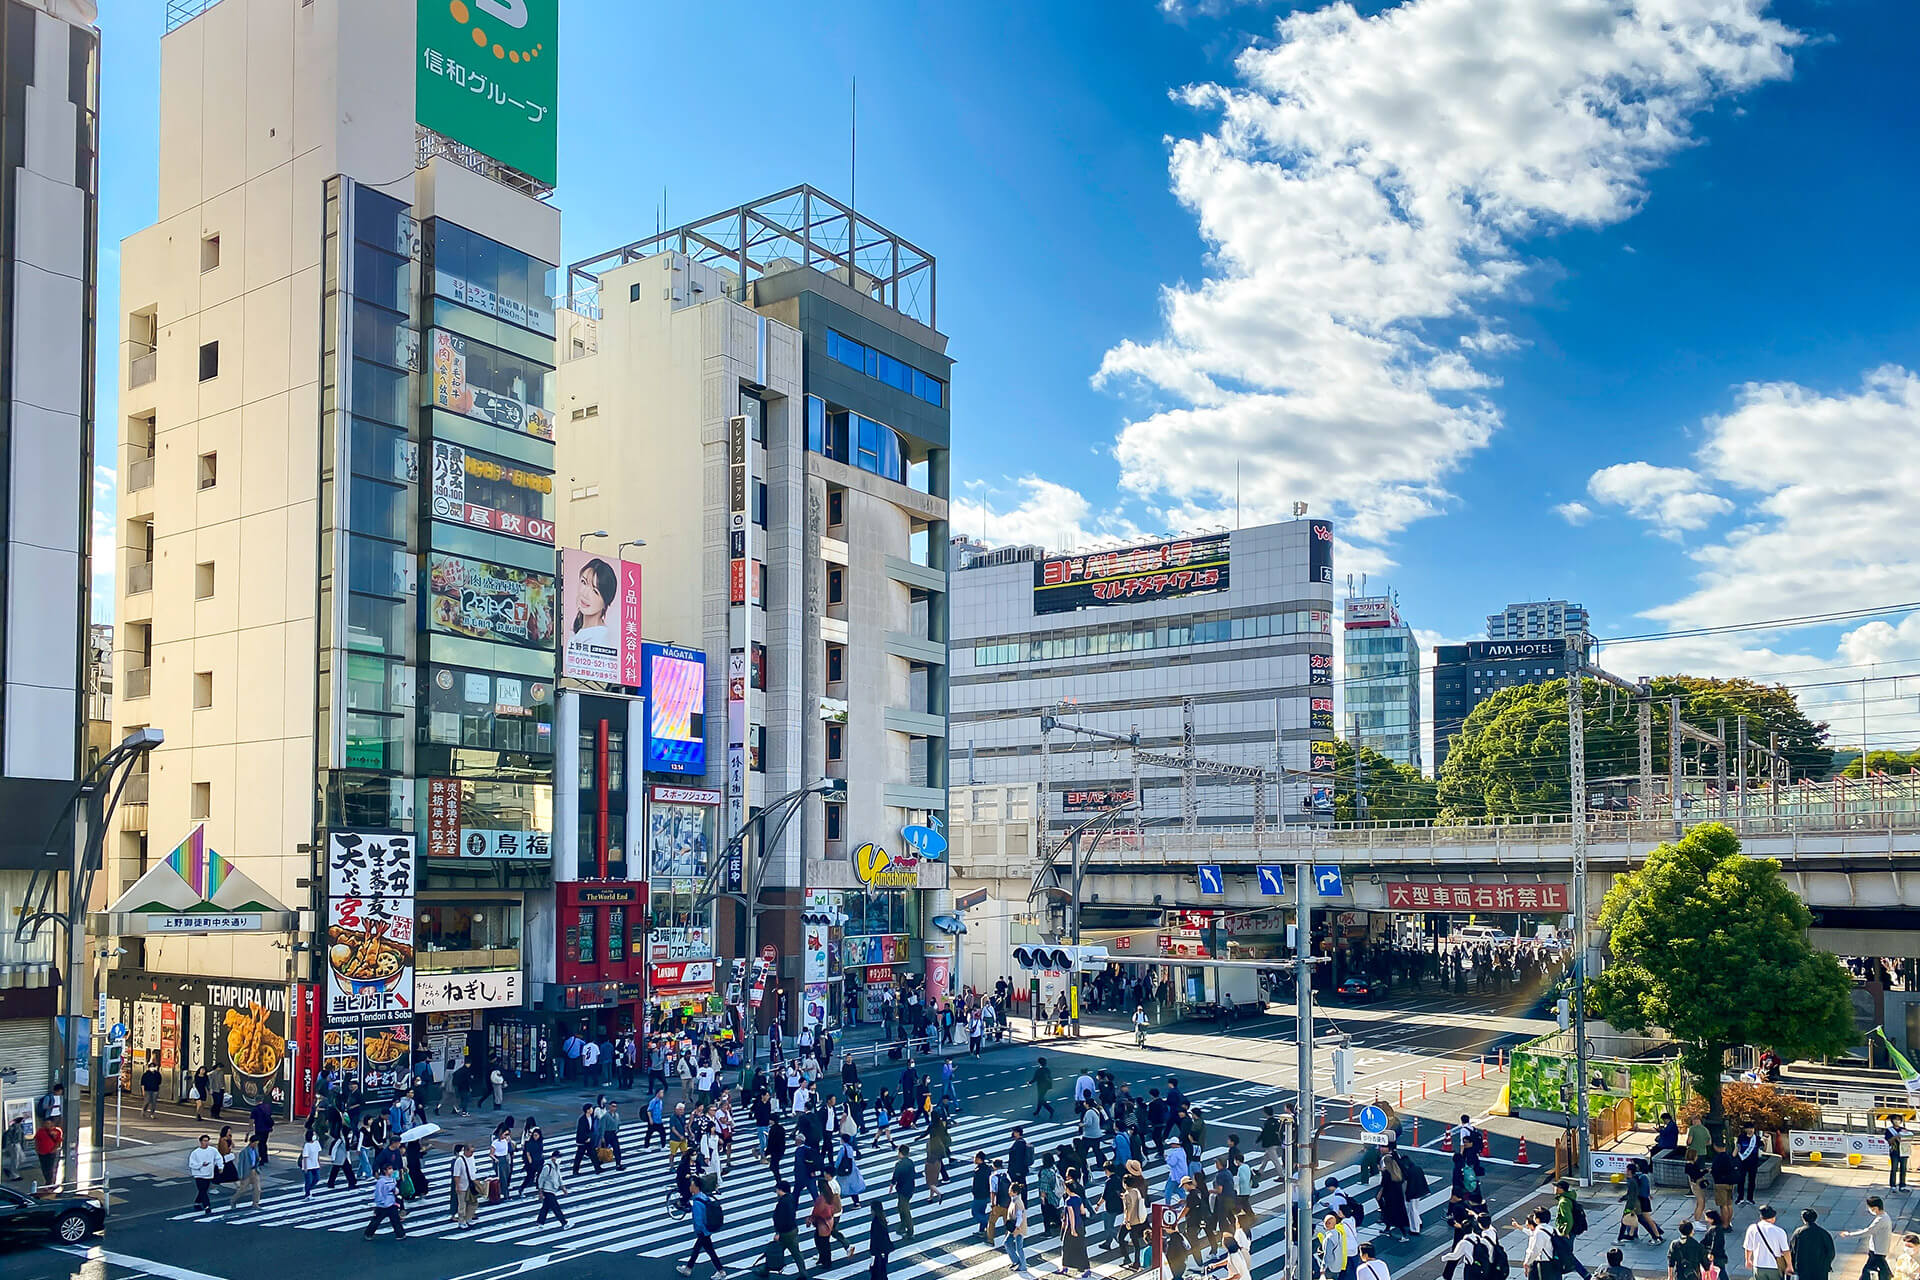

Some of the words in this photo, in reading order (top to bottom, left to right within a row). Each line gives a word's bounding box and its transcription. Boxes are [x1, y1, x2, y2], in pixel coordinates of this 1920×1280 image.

[424, 47, 548, 123] 信和グループ
[1043, 542, 1192, 586] ヨドバシカメラ
[1092, 569, 1219, 600] マルチメディア上野
[625, 590, 637, 683] 品川美容外科
[1489, 645, 1512, 656] APA
[1515, 644, 1553, 654] HOTEL
[662, 648, 693, 660] NAGATA
[662, 789, 714, 802] スポーツジュエン
[432, 782, 444, 853] 鉄板焼き餃子
[495, 834, 549, 856] 鳥福
[857, 842, 917, 894] Yamashiroya
[368, 844, 393, 920] 生蕎麦
[1392, 886, 1562, 908] 大型車両右折禁止
[164, 918, 248, 928] 上野御徒町中央通り
[207, 985, 261, 1008] TEMPURA
[442, 979, 497, 1006] ねぎし
[327, 1014, 359, 1024] Tempura
[360, 1013, 386, 1022] Tendon
[388, 1012, 393, 1020] &
[394, 1011, 412, 1020] Soba
[192, 1032, 201, 1066] ねぎし
